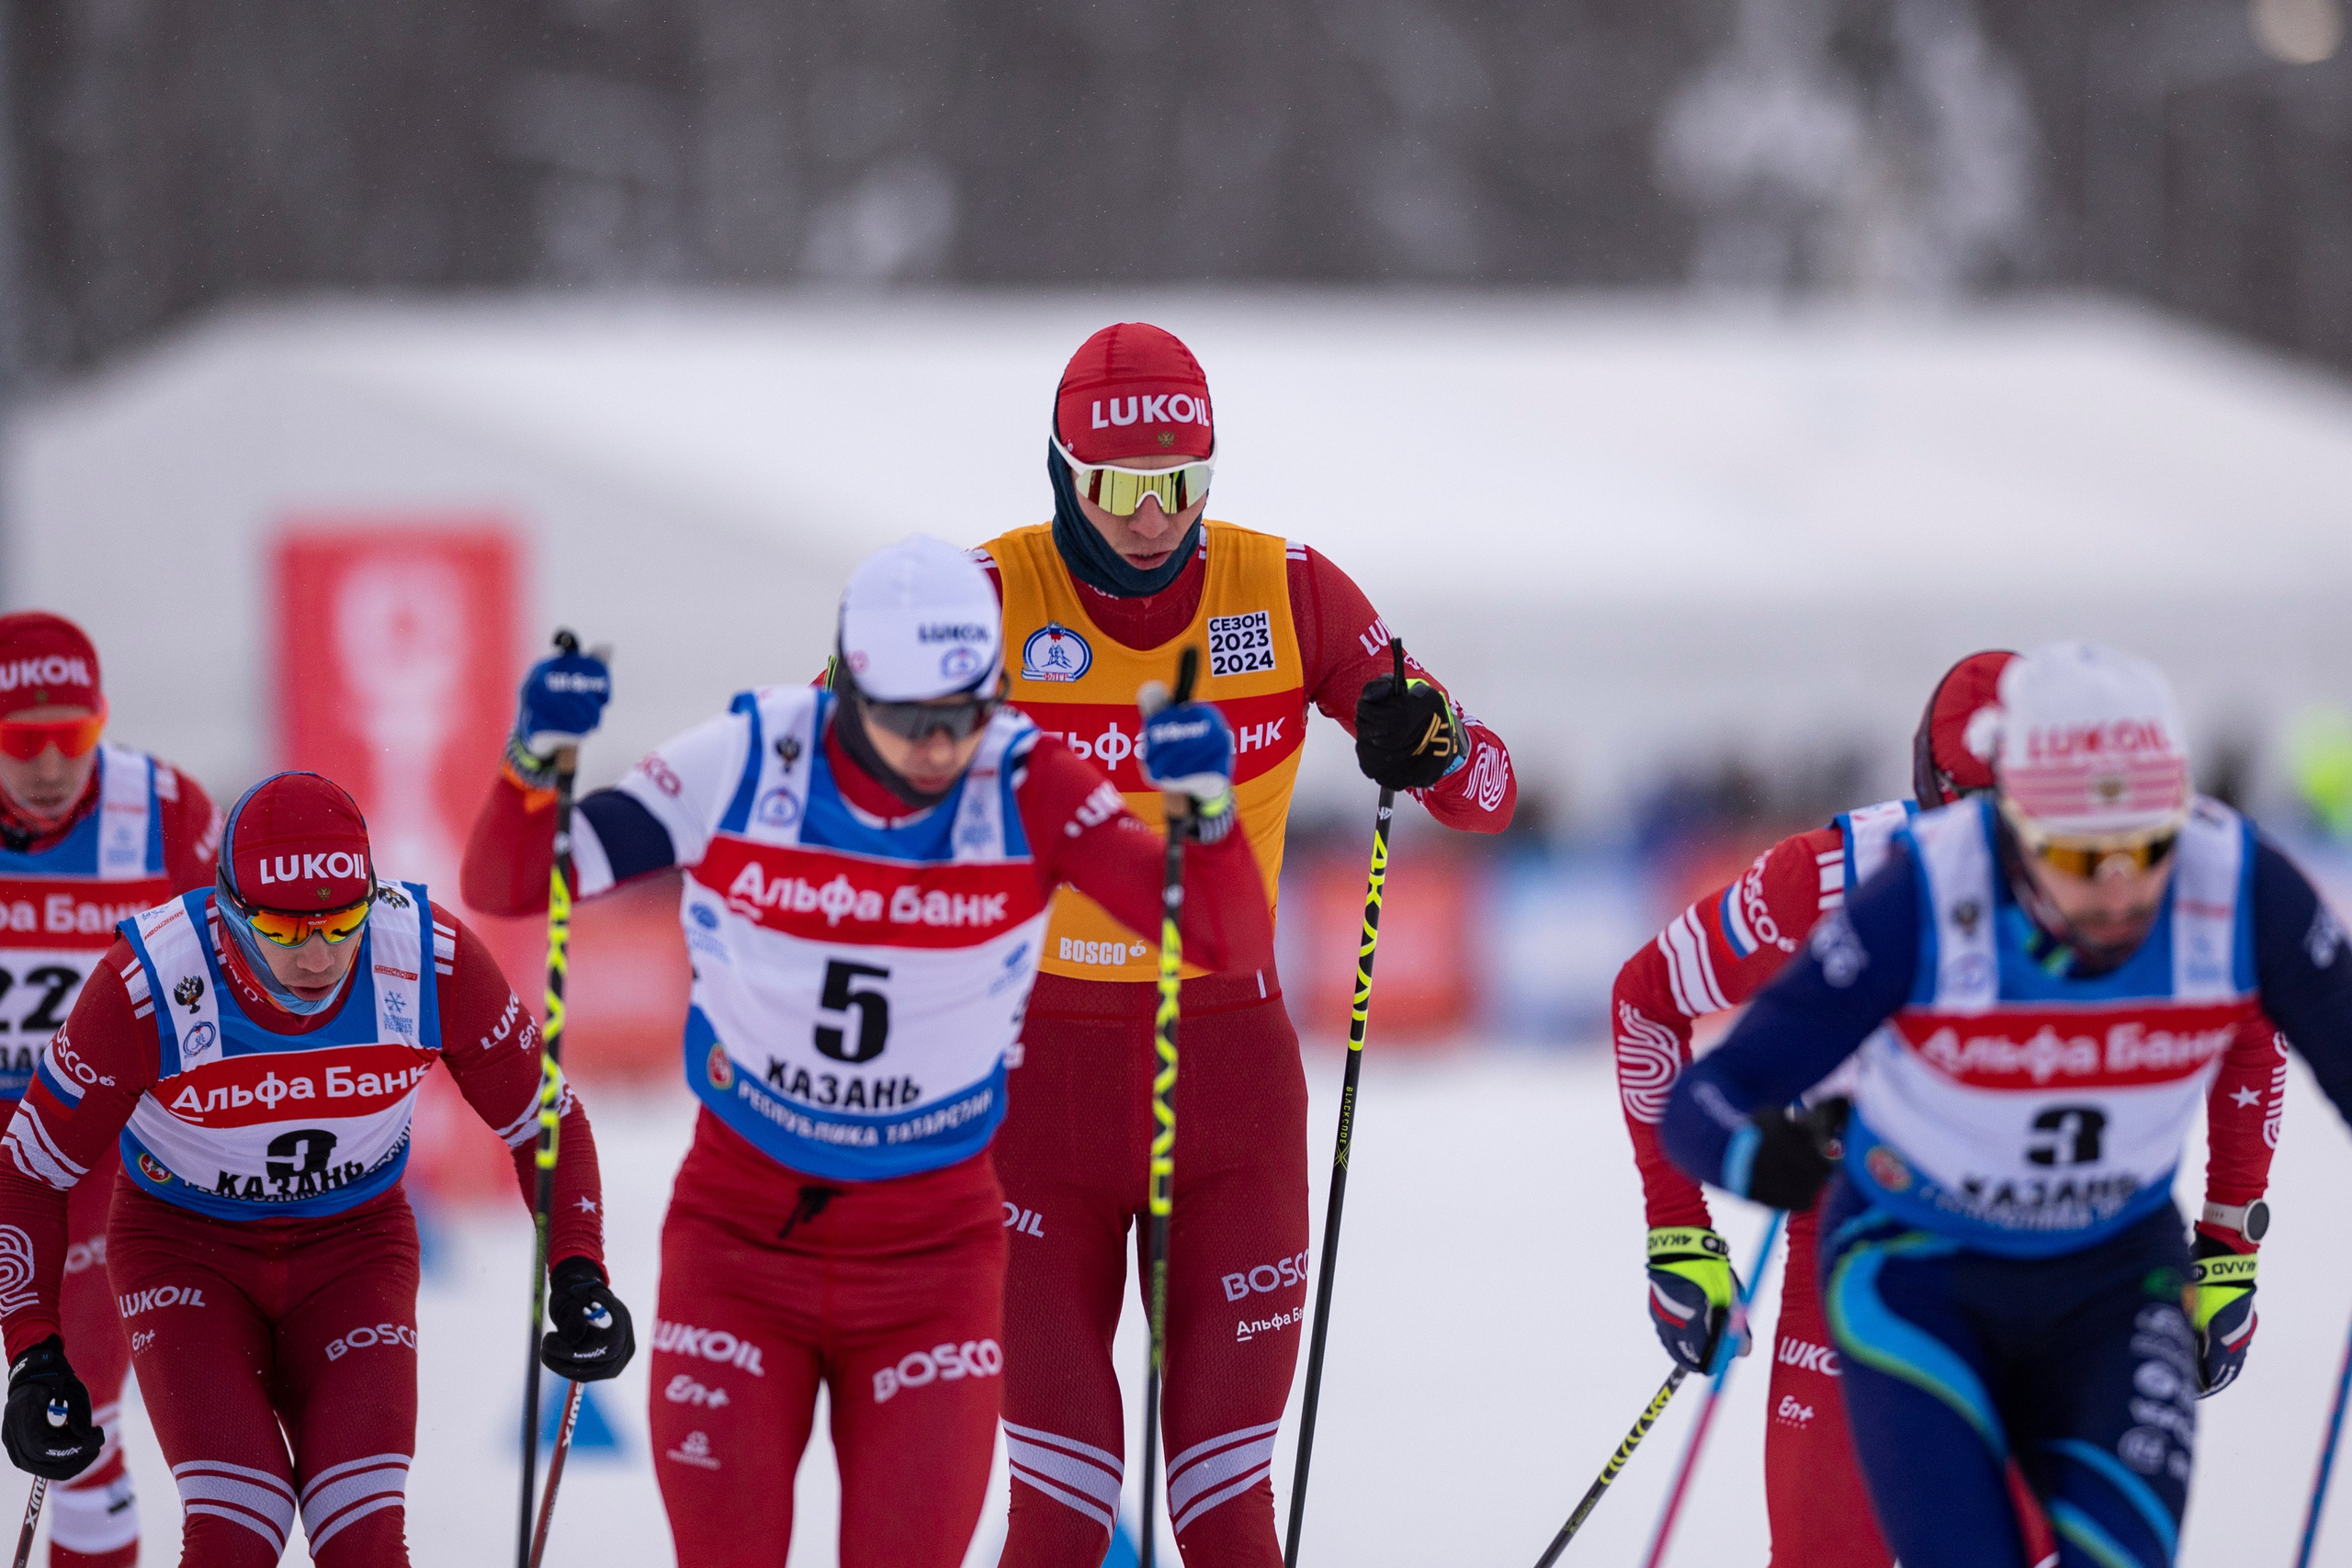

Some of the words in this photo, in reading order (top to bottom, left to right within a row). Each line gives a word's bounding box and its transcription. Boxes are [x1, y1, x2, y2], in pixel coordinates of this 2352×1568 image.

[1091, 393, 1210, 430] LUKOIL
[1209, 612, 1267, 632] СЕЗОН
[1211, 628, 1270, 653] 2023
[0, 656, 90, 693] UKOIL
[1213, 650, 1275, 676] 2024
[260, 852, 367, 884] LUKOIL
[729, 862, 883, 927] Альфа
[889, 885, 1009, 927] Банк
[1059, 937, 1126, 965] BOSCO
[0, 966, 81, 1032] 2
[815, 959, 890, 1064] 5
[1922, 1025, 2100, 1084] Альфа
[171, 1072, 315, 1114] Альфа
[325, 1062, 431, 1098] Банк
[766, 1058, 920, 1109] КАЗАНЬ
[1340, 1086, 1353, 1145] BLACKCODE
[1001, 1201, 1045, 1238] OIL
[119, 1285, 206, 1318] LUKOIL
[324, 1323, 418, 1361] BOSCO
[1237, 1313, 1292, 1342] Альфа
[872, 1338, 1004, 1404] BOSCO
[1778, 1337, 1841, 1377] LUKO
